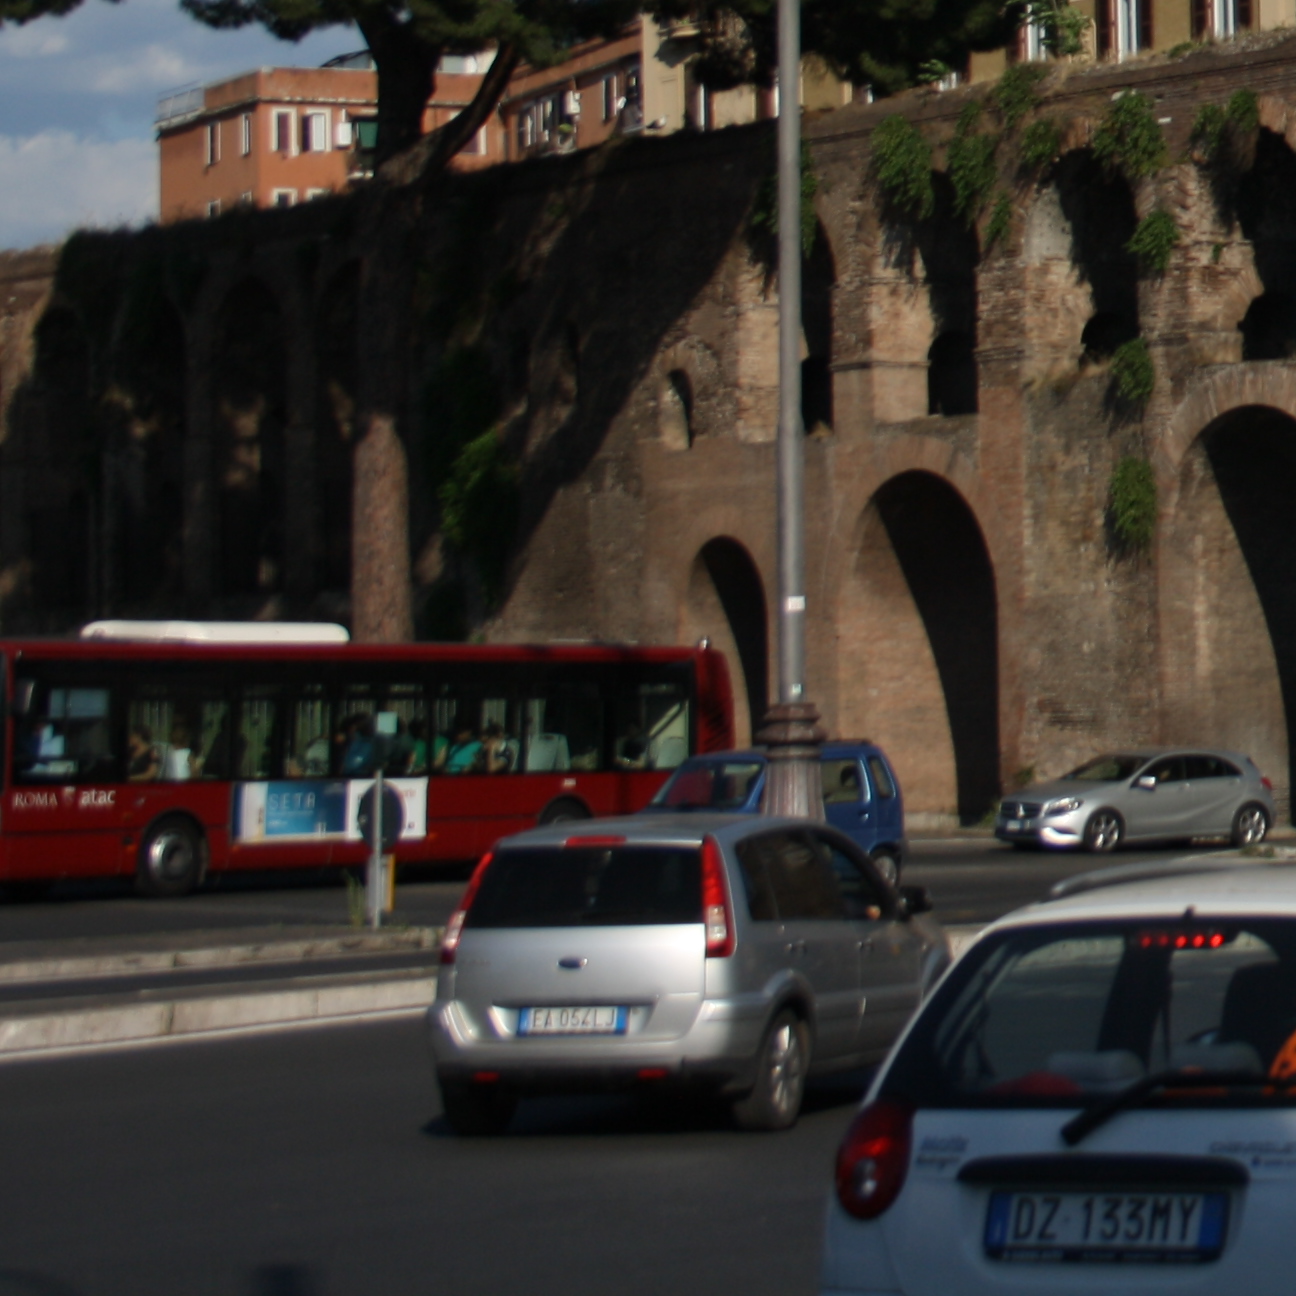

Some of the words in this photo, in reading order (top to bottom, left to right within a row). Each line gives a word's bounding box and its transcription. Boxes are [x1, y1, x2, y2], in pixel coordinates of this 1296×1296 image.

[14, 791, 58, 806] ROMA
[80, 789, 116, 806] atac
[268, 791, 316, 811] SETA
[1012, 1197, 1061, 1241] DZ
[1082, 1197, 1197, 1243] 133MY
